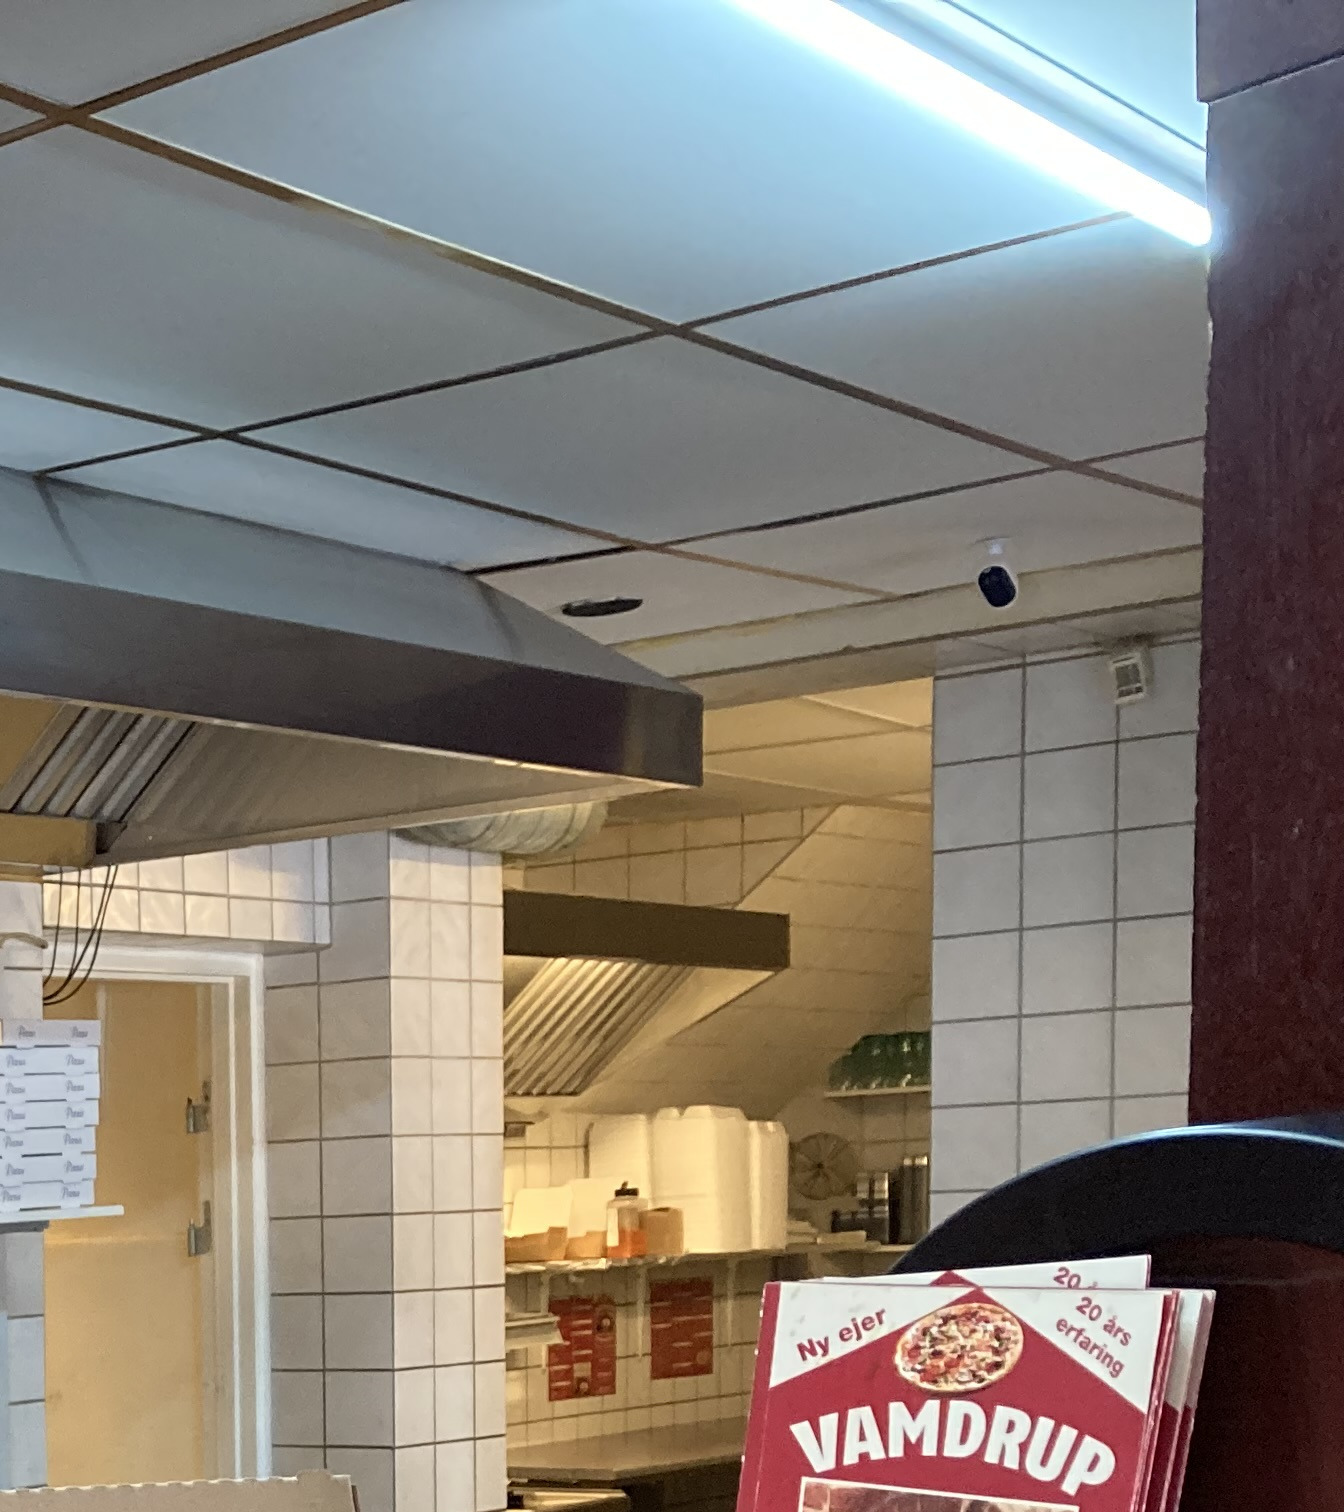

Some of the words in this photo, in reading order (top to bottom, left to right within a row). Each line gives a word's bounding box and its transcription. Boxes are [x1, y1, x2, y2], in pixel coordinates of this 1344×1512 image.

[797, 1338, 831, 1363] Ny
[839, 1308, 887, 1343] ejer
[1056, 1316, 1125, 1379] erfaring
[1076, 1297, 1103, 1321] 20
[1105, 1316, 1132, 1347] års
[789, 1399, 1115, 1497] VAMDRUP
